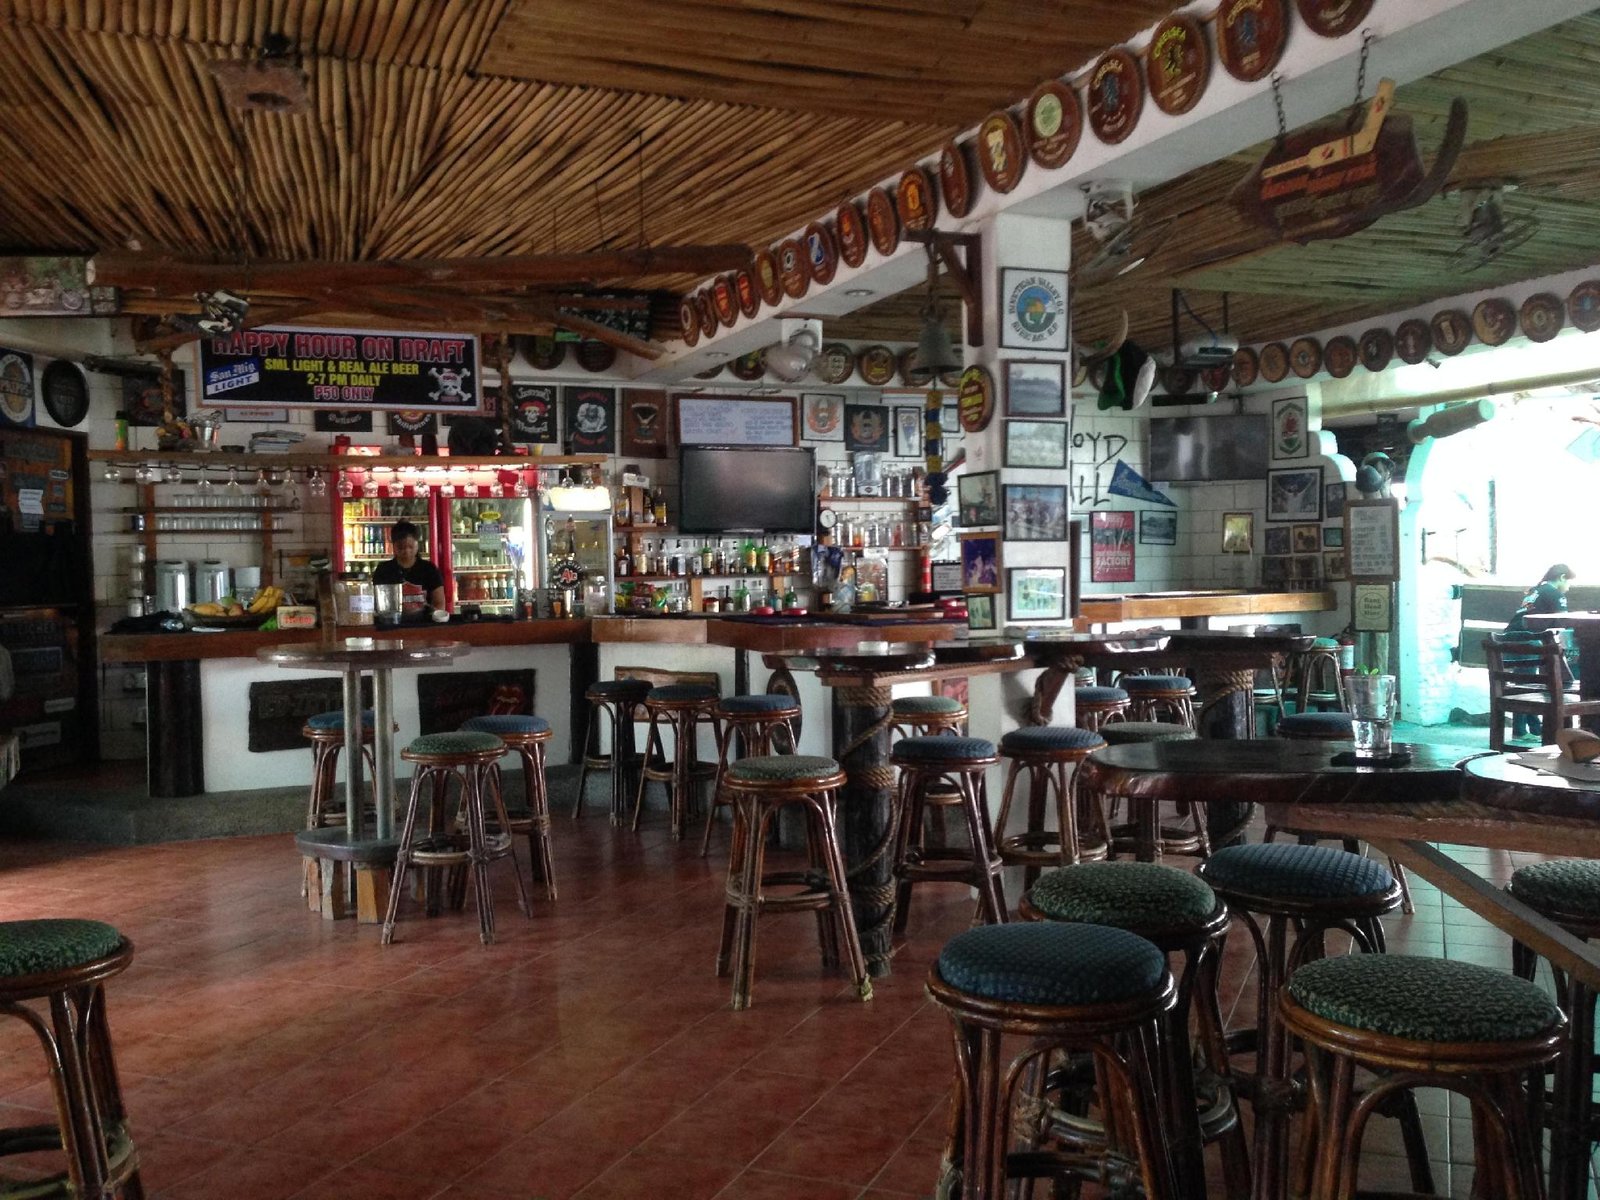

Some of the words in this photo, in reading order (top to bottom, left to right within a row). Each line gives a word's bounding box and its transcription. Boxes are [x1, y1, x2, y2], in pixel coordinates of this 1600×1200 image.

[212, 332, 289, 357] HAPPY
[295, 334, 357, 360] HOUR
[362, 337, 394, 361] ON
[400, 338, 465, 363] DRAFT
[265, 358, 290, 370] SML
[293, 360, 325, 372] LIGHT
[327, 361, 336, 372] &
[339, 361, 367, 374] REAL
[369, 362, 389, 374] ALE
[392, 363, 419, 375] BEER
[215, 375, 253, 391] LIGHT
[306, 373, 326, 385] 2-7
[329, 374, 347, 386] PM
[350, 374, 381, 387] DAILY
[314, 386, 339, 400] P50
[342, 387, 375, 401] ONLY
